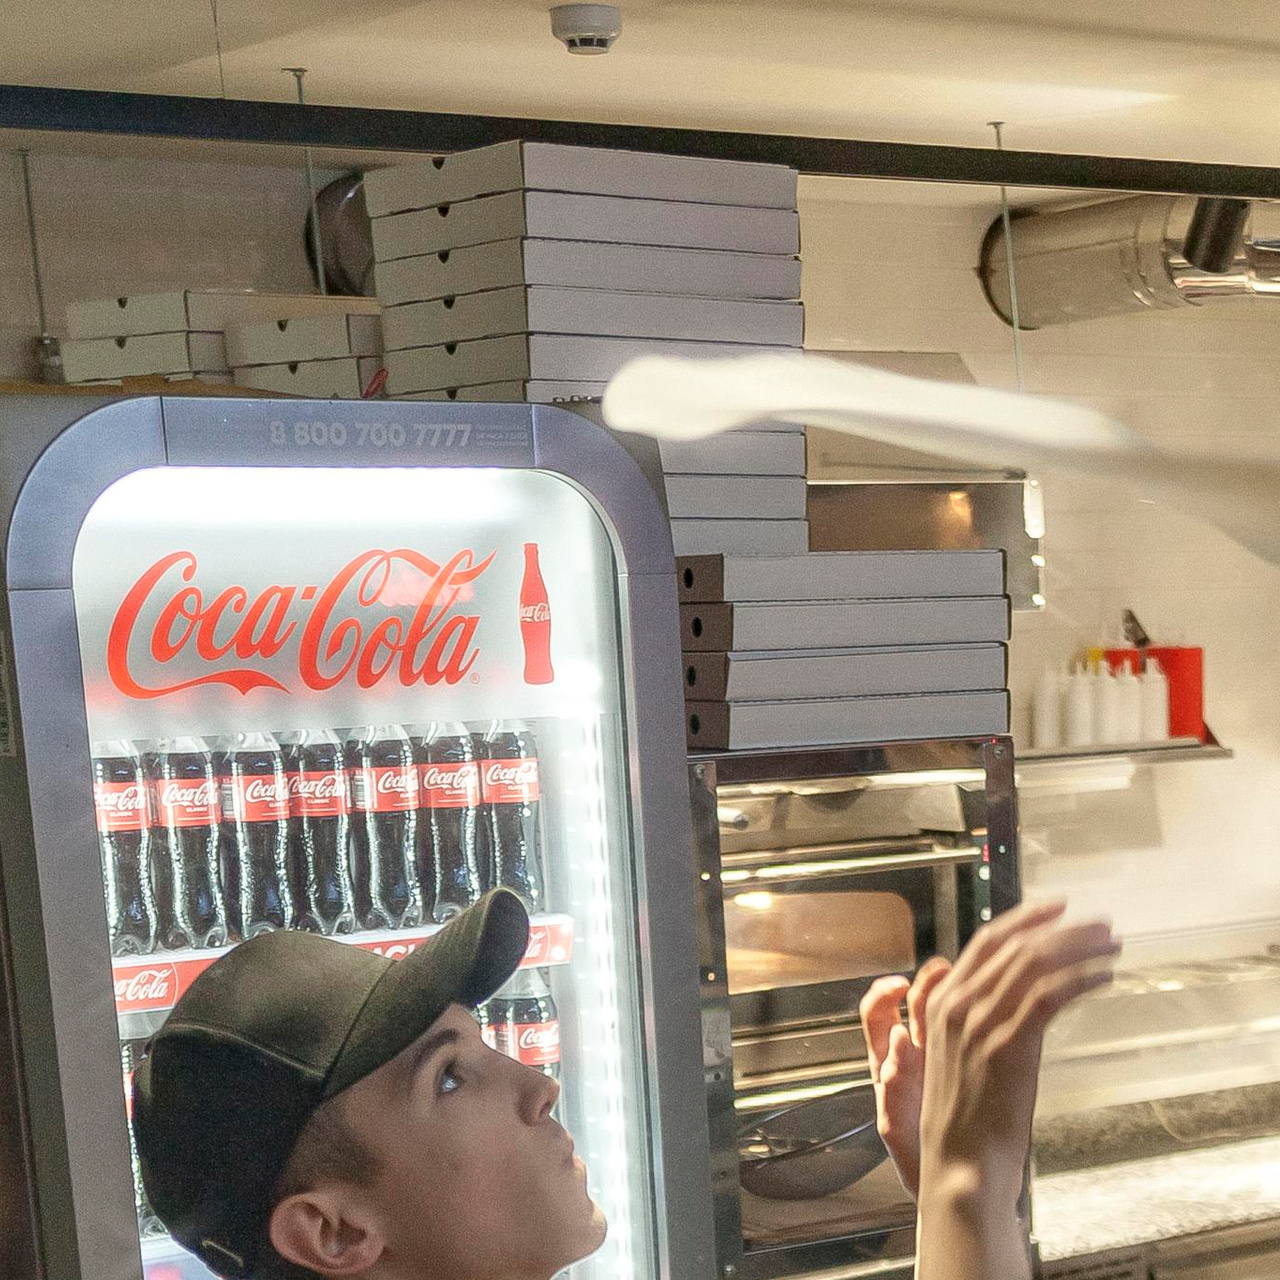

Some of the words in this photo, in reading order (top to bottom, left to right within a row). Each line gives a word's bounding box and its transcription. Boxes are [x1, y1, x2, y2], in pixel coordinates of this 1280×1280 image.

[269, 421, 285, 445] 8
[294, 421, 348, 446] 800
[355, 423, 406, 446] 700
[412, 423, 472, 447] 7777
[107, 547, 498, 699] Coca-Cola
